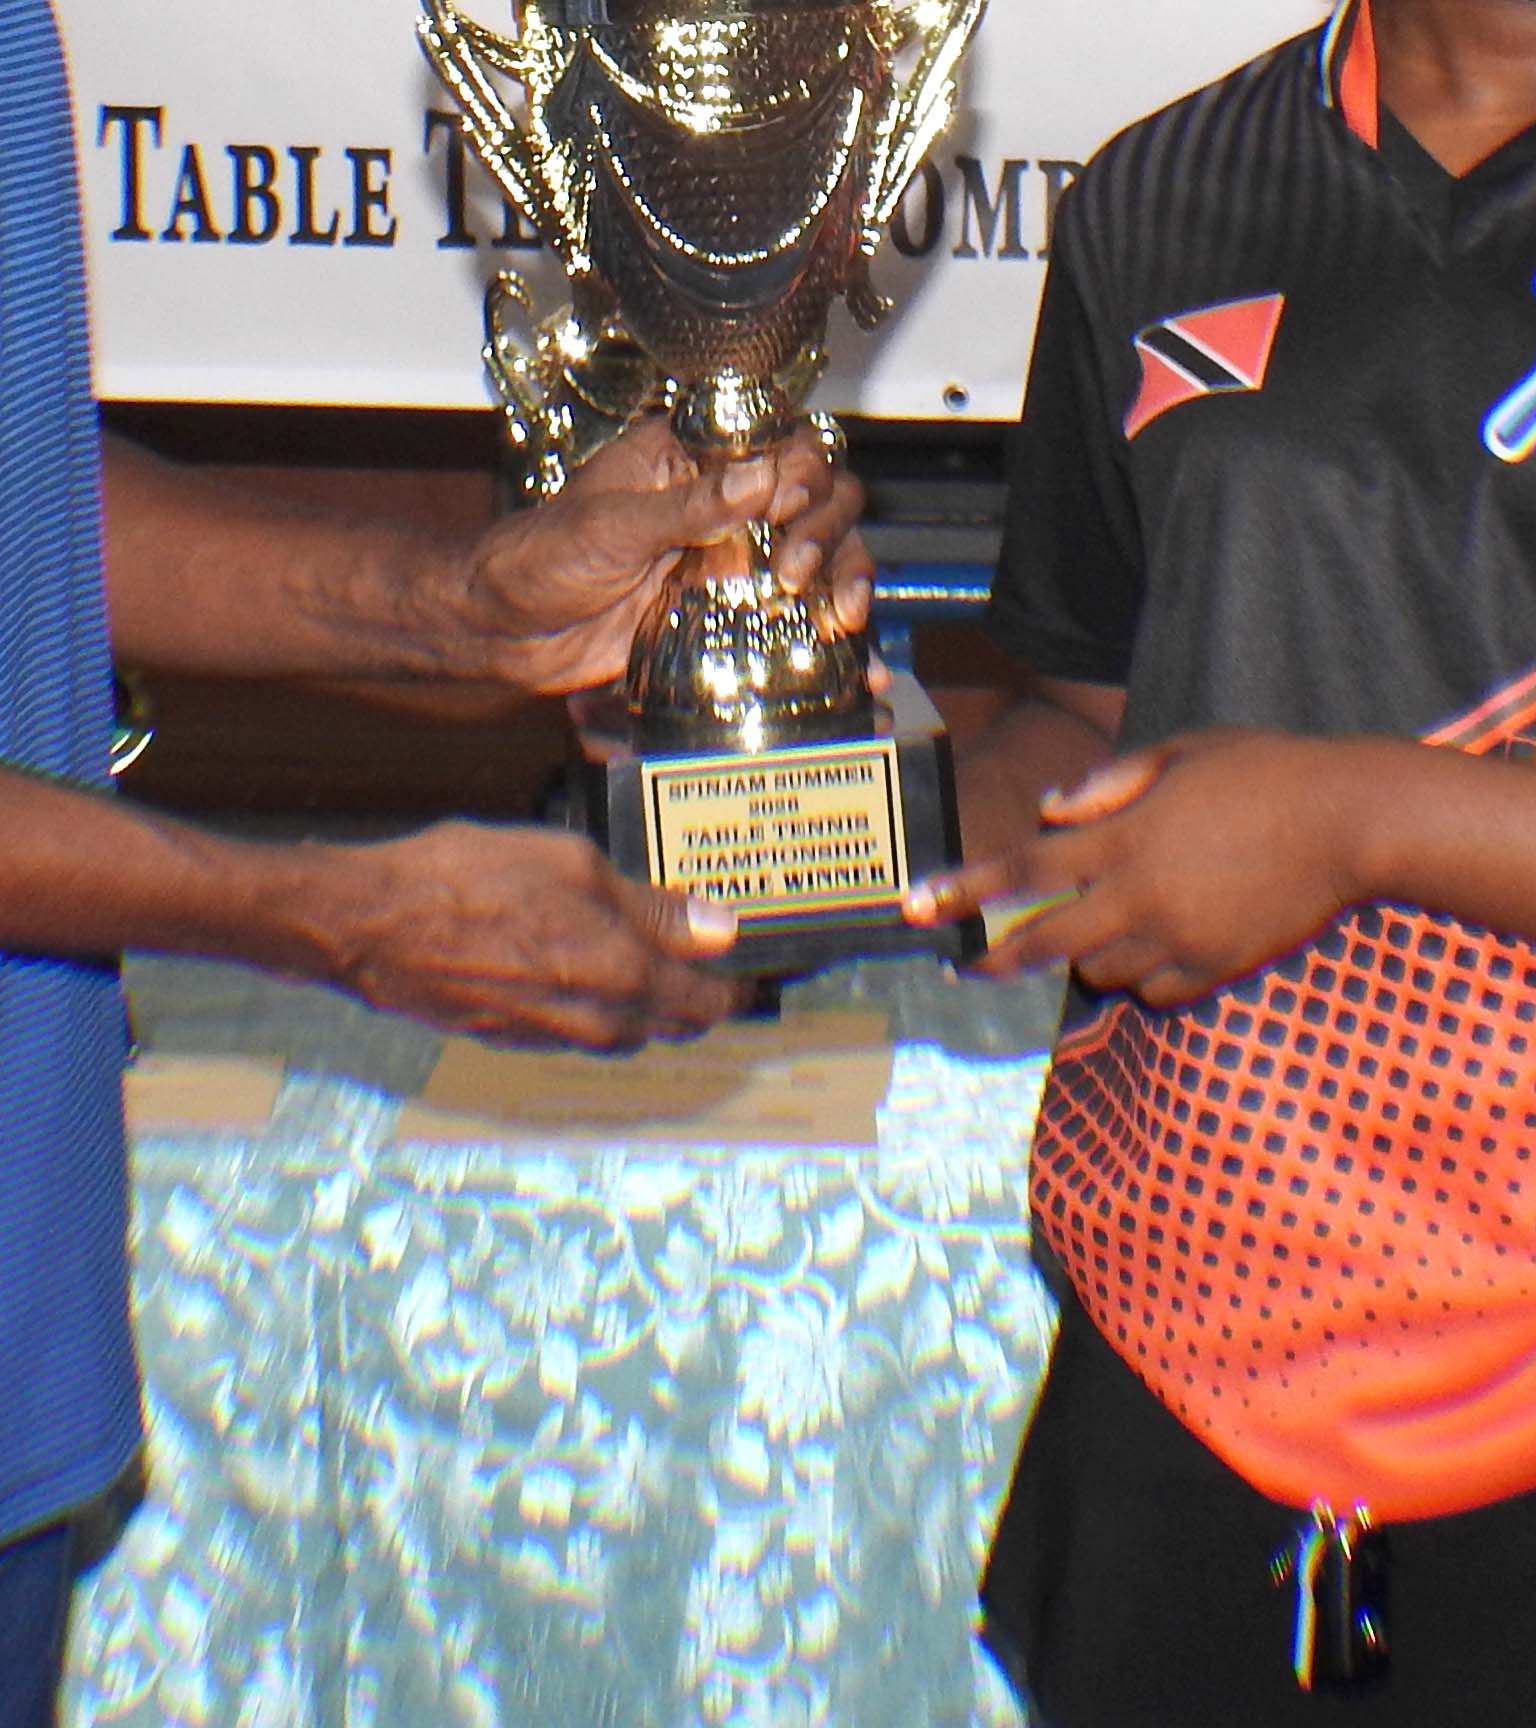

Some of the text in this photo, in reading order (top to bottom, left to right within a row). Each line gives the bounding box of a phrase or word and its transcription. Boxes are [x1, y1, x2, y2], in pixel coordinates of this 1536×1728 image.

[97, 104, 398, 249] TABLE
[668, 763, 875, 802] SPINJAM SUMMER
[681, 813, 870, 849] TABLE TENNIS
[677, 838, 879, 874] CHAMPIONSHIP
[783, 862, 887, 892] WINNER
